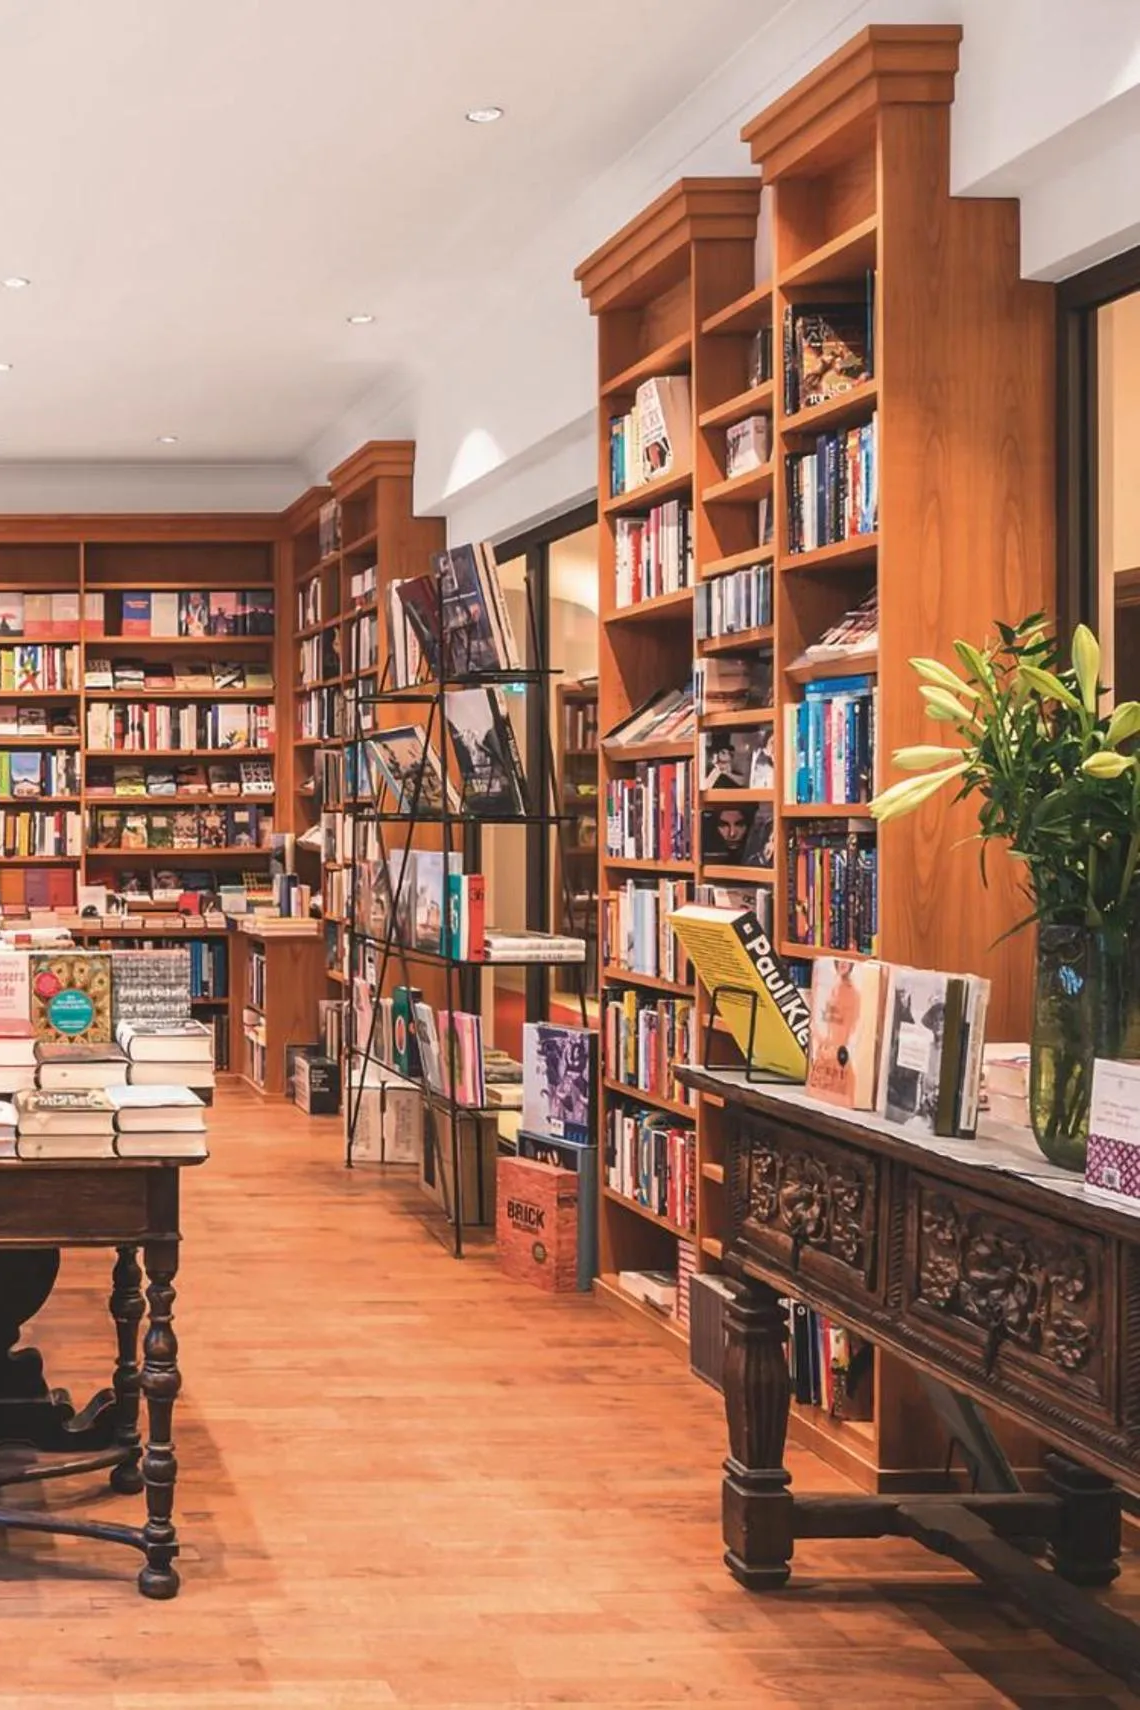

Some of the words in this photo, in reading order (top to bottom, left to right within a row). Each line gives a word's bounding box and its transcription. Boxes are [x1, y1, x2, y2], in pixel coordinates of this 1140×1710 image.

[746, 934, 794, 1000] Paul
[781, 996, 810, 1054] Kle
[507, 1200, 545, 1230] BRICK
